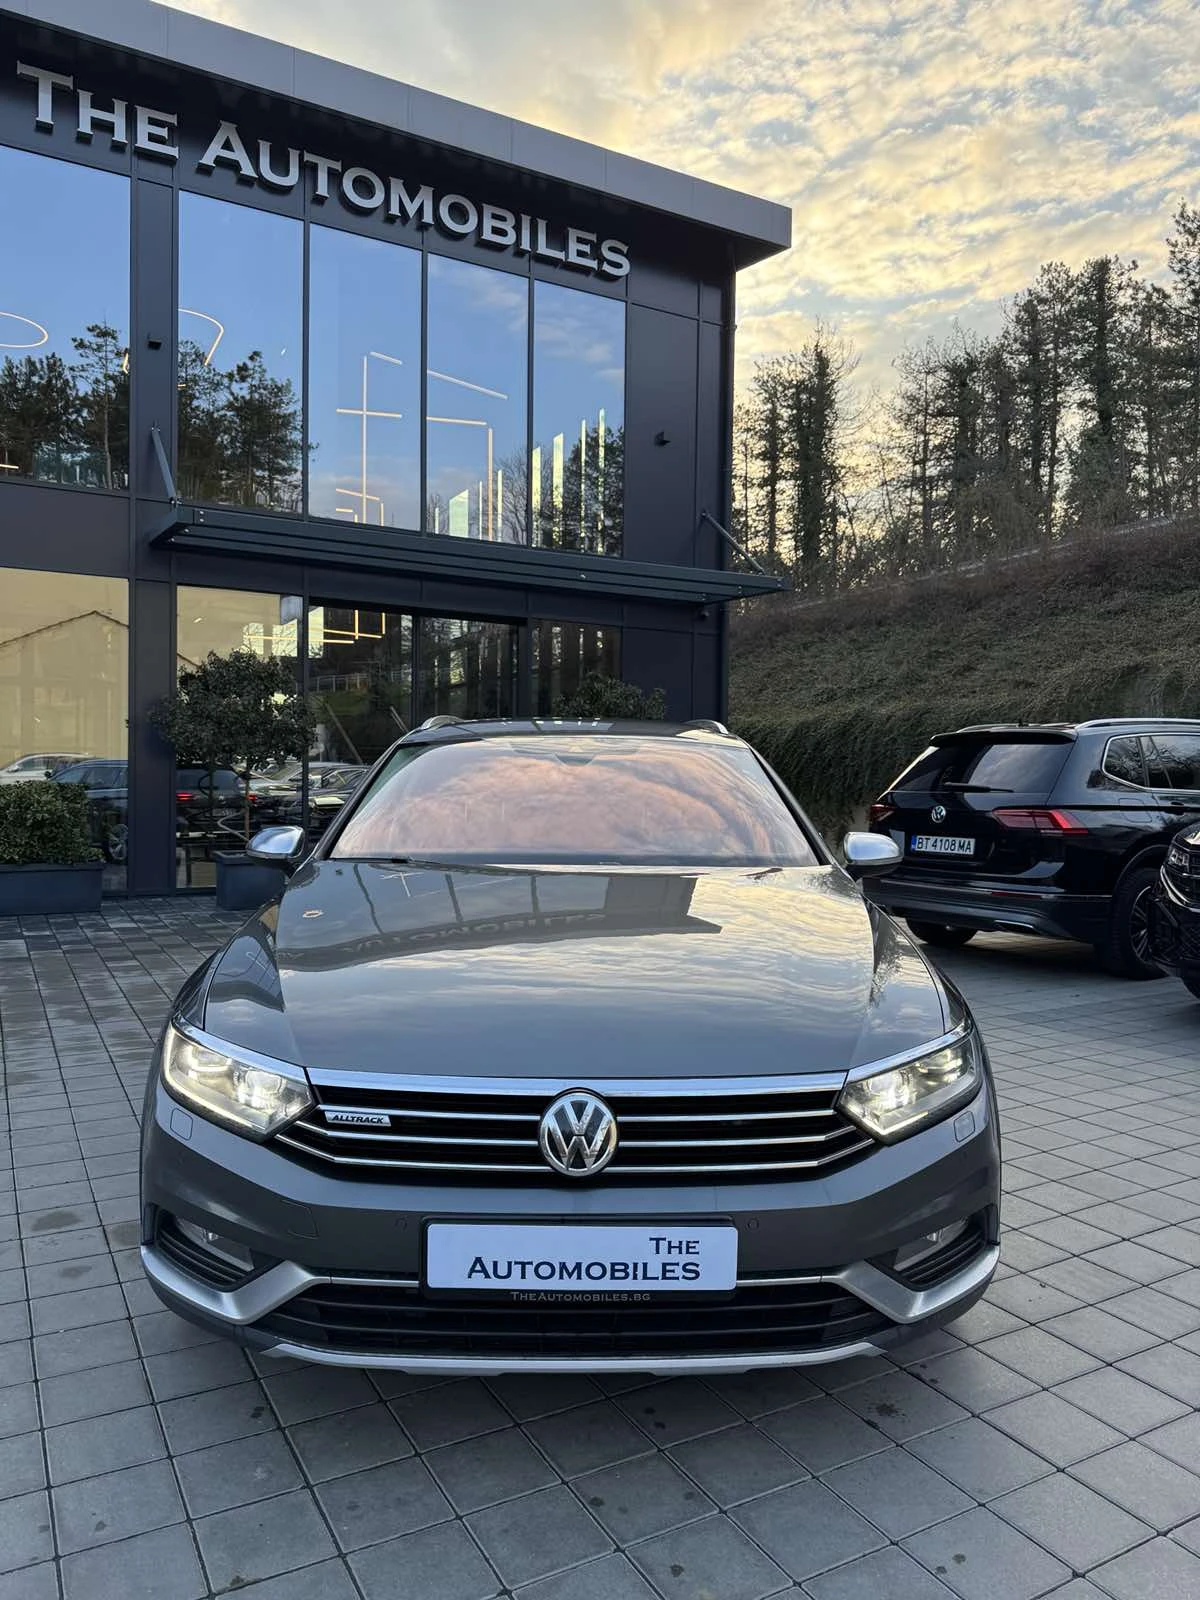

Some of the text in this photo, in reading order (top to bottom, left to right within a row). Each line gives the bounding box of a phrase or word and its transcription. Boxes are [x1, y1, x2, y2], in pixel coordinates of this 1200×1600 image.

[16, 60, 632, 278] THE AUTOMOBILES
[931, 838, 956, 852] 4108
[332, 1113, 384, 1124] ALLTRACK
[649, 1237, 700, 1255] THE
[467, 1256, 701, 1281] AUTOMOBILES
